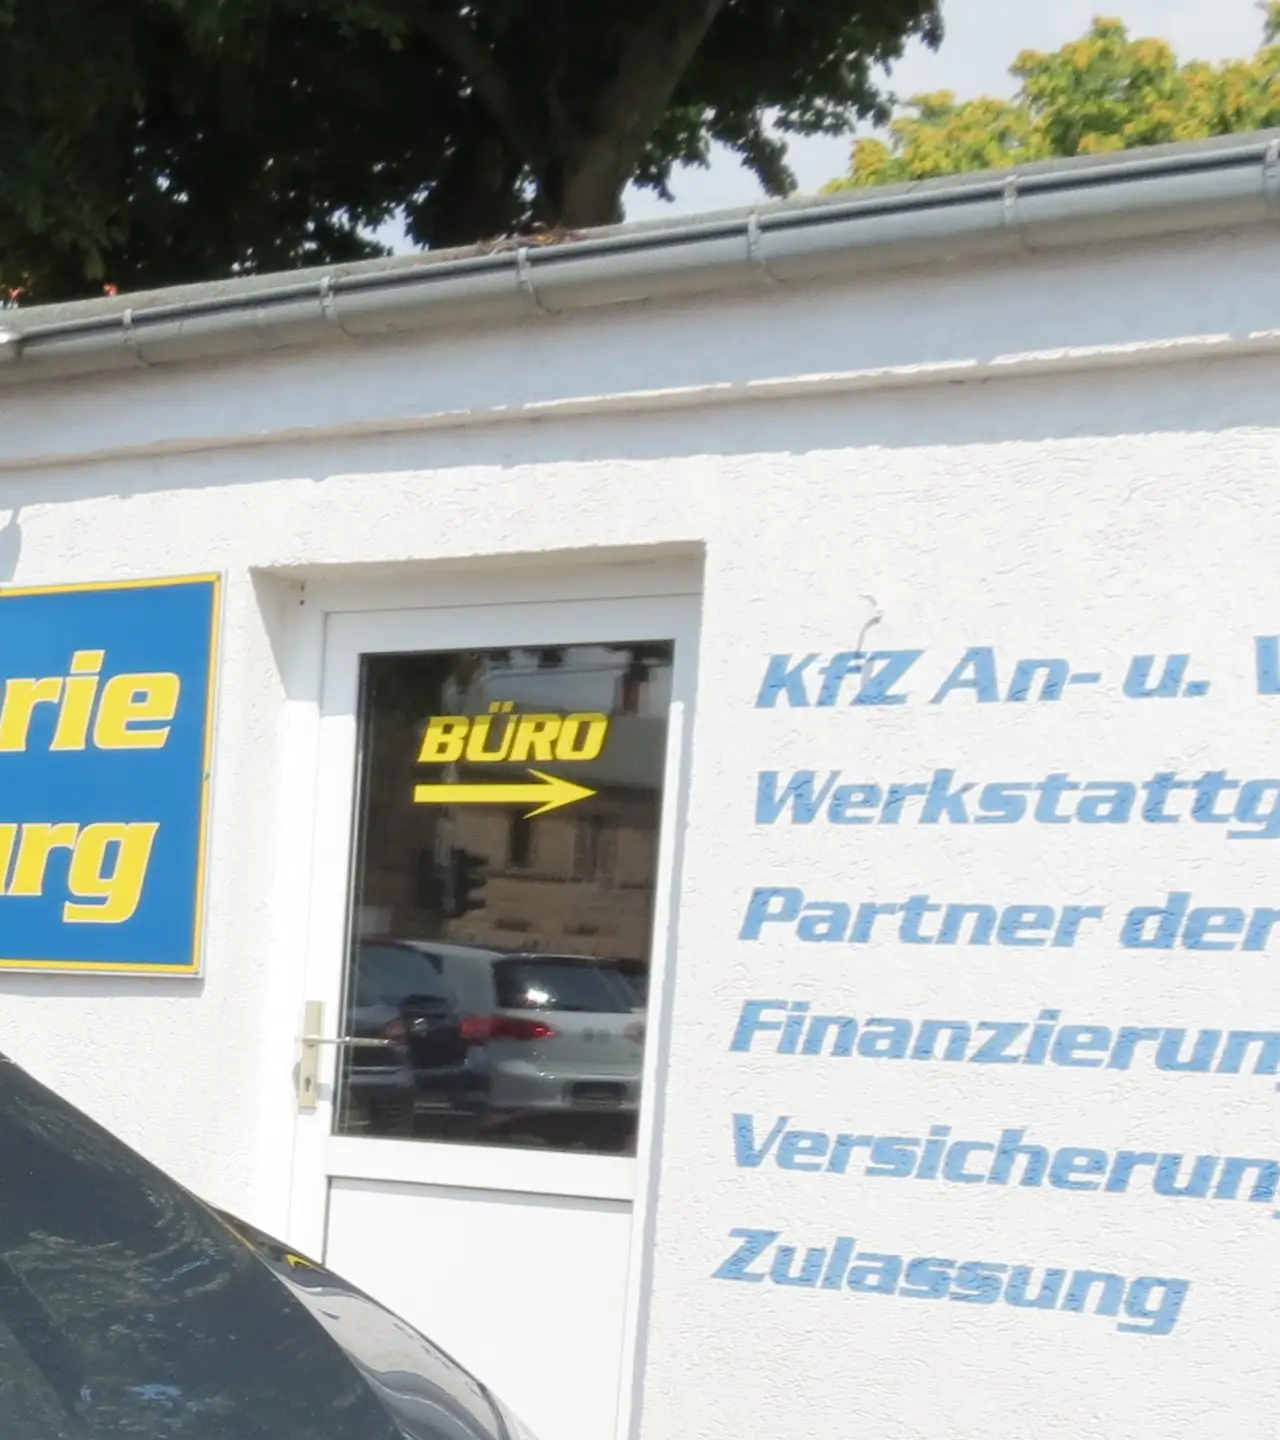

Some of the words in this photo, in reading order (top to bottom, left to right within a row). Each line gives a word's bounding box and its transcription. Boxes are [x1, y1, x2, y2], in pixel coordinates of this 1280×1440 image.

[754, 649, 925, 709] KfZ
[928, 645, 1102, 704] An-
[1122, 653, 1211, 699] u.
[416, 700, 610, 764] BÜRO
[738, 886, 1105, 948] Partner
[1119, 890, 1280, 951] der
[728, 998, 1280, 1092] Finanzierun
[731, 1112, 1280, 1219] Versicherun
[712, 1227, 1191, 1336] Zulassung
